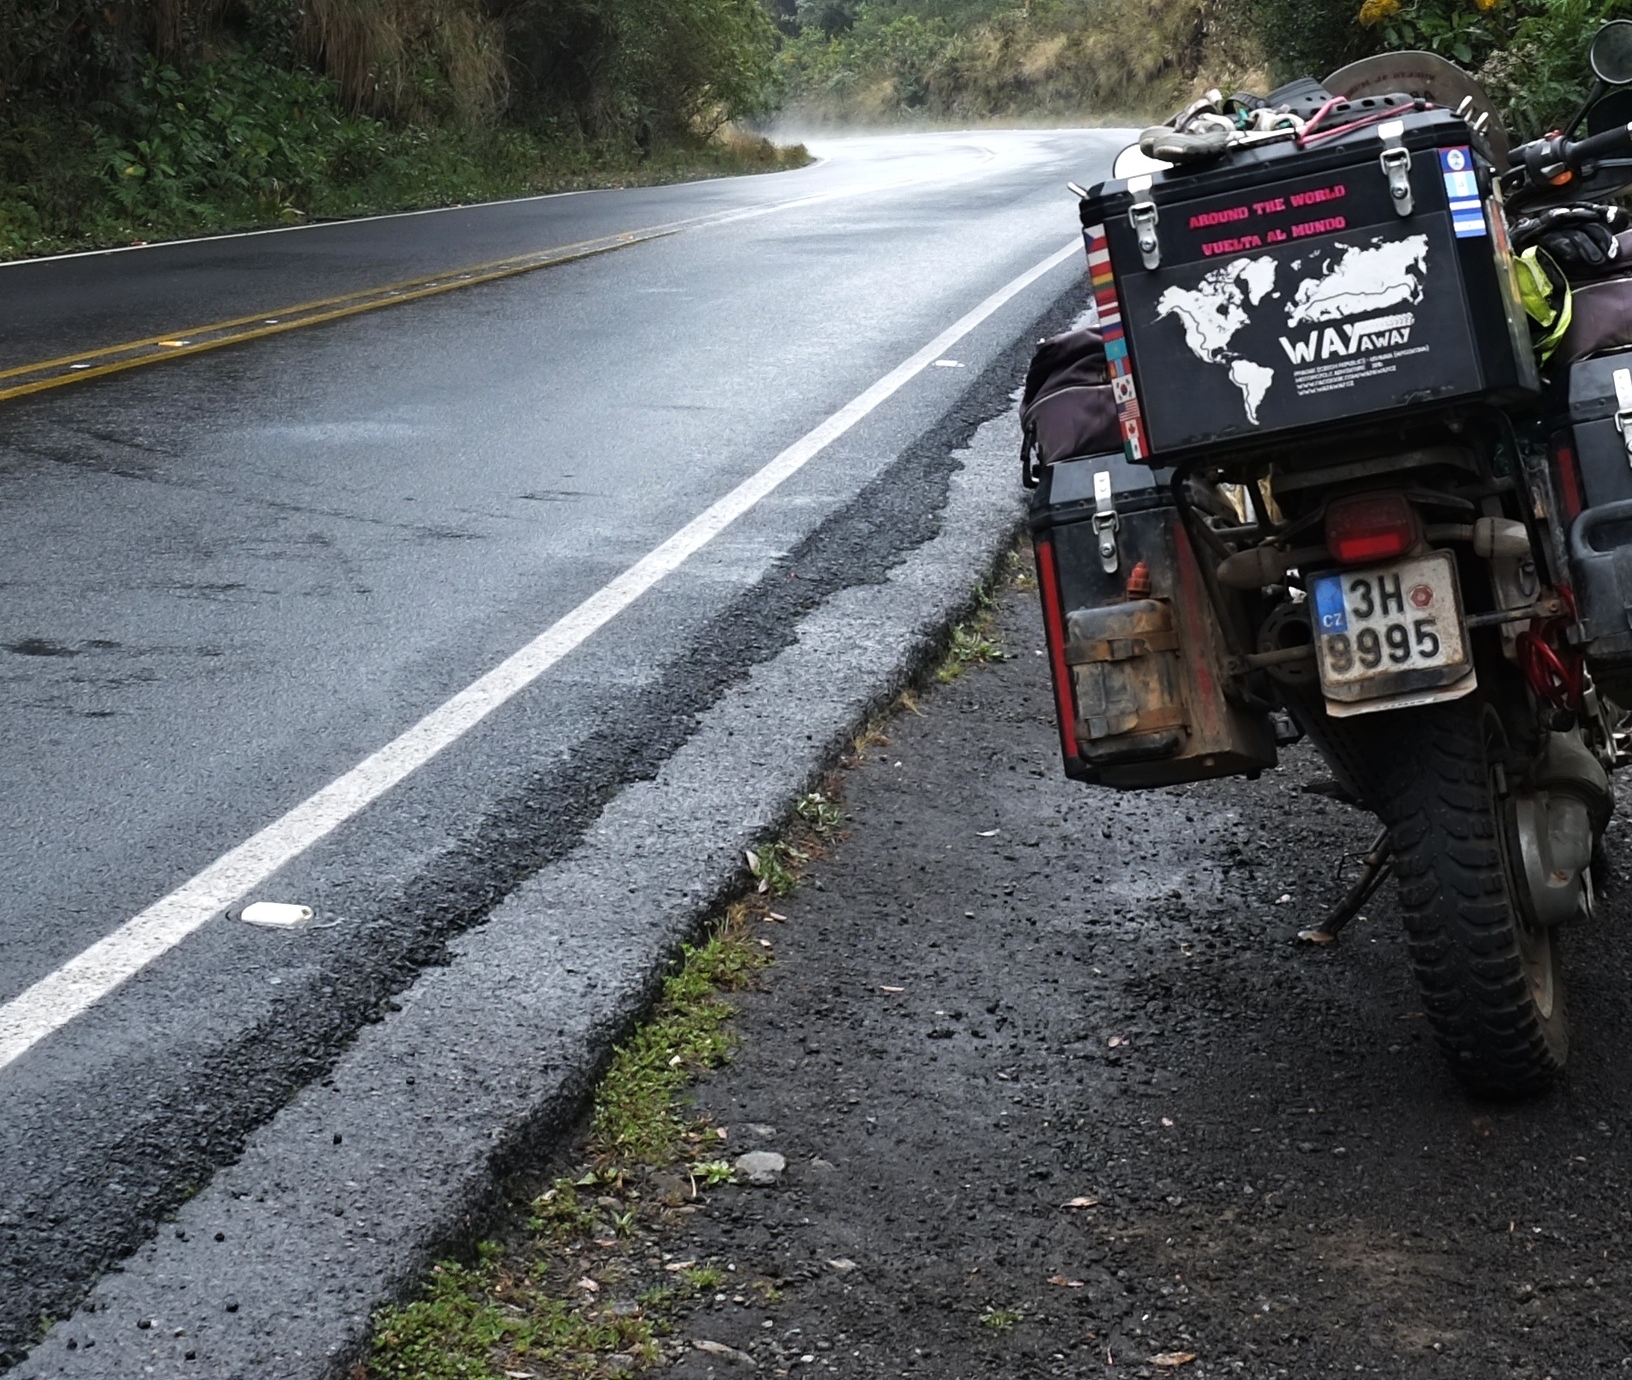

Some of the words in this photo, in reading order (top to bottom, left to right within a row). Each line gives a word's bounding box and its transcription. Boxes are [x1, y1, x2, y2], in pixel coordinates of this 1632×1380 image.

[1188, 207, 1249, 229] AROUND
[1253, 198, 1286, 215] THE
[1290, 185, 1346, 207] WORLD
[1202, 235, 1262, 256] VUELTA
[1267, 229, 1287, 242] AL
[1291, 216, 1346, 237] MUNDO
[1278, 322, 1365, 365] WAY
[1361, 327, 1411, 352] AWAY
[1350, 572, 1404, 619] 3H
[1322, 613, 1344, 628] CZ
[1327, 619, 1440, 675] 9995
